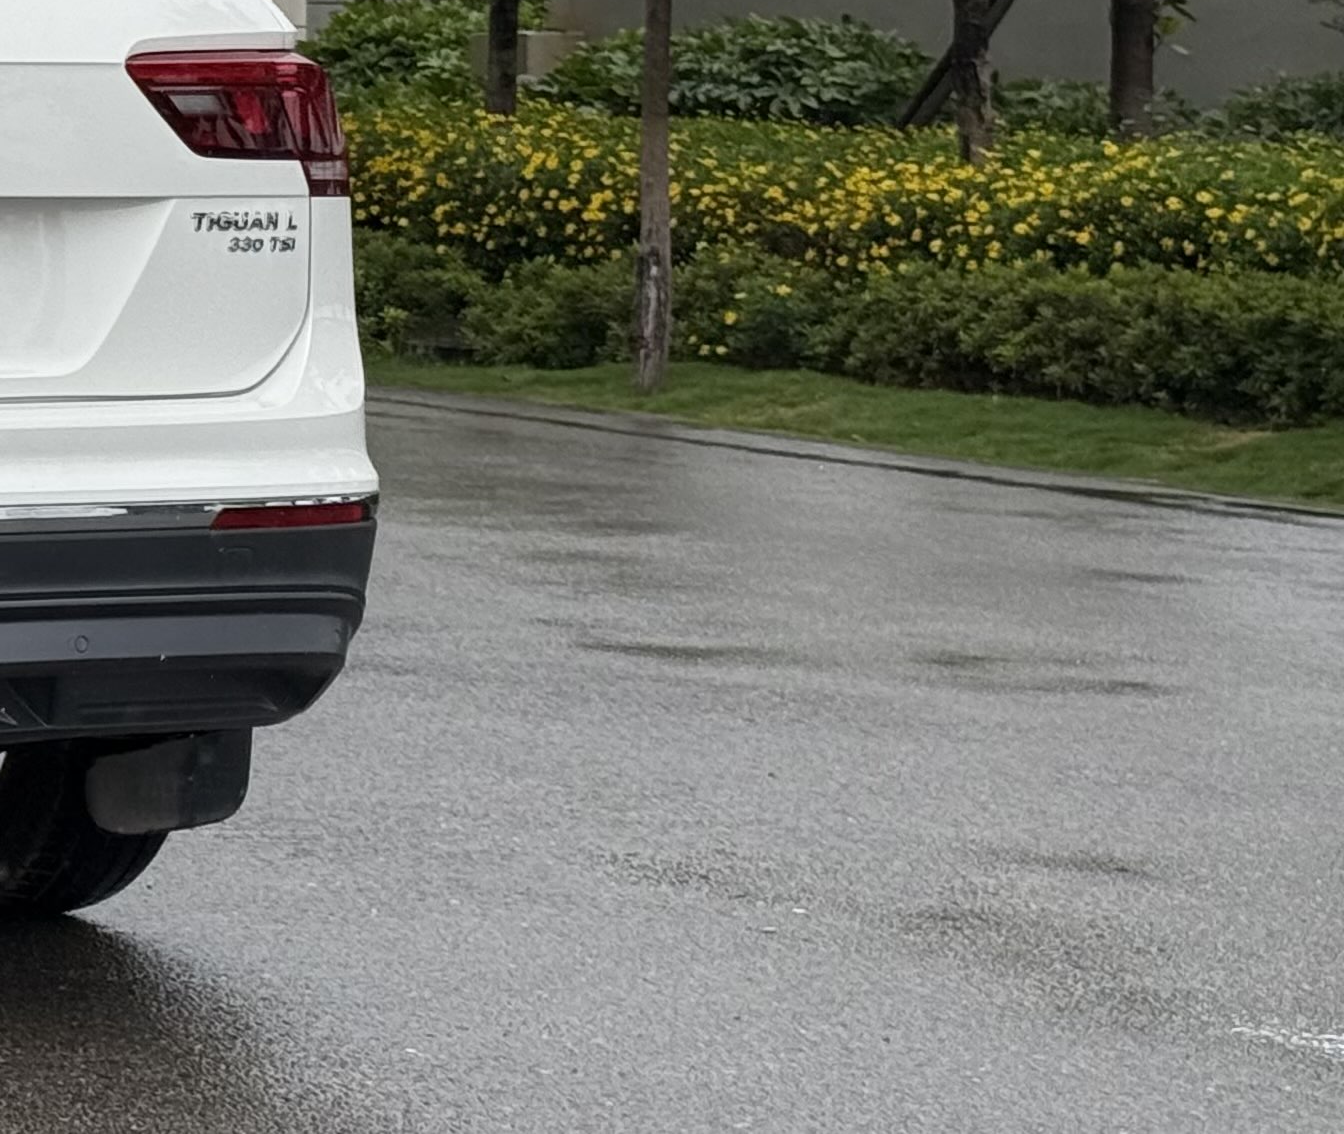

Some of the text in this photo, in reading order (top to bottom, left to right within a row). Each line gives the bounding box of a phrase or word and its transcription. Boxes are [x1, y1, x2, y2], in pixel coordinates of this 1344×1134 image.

[191, 211, 298, 232] TIGUAN L
[227, 236, 296, 253] 330 TSI
